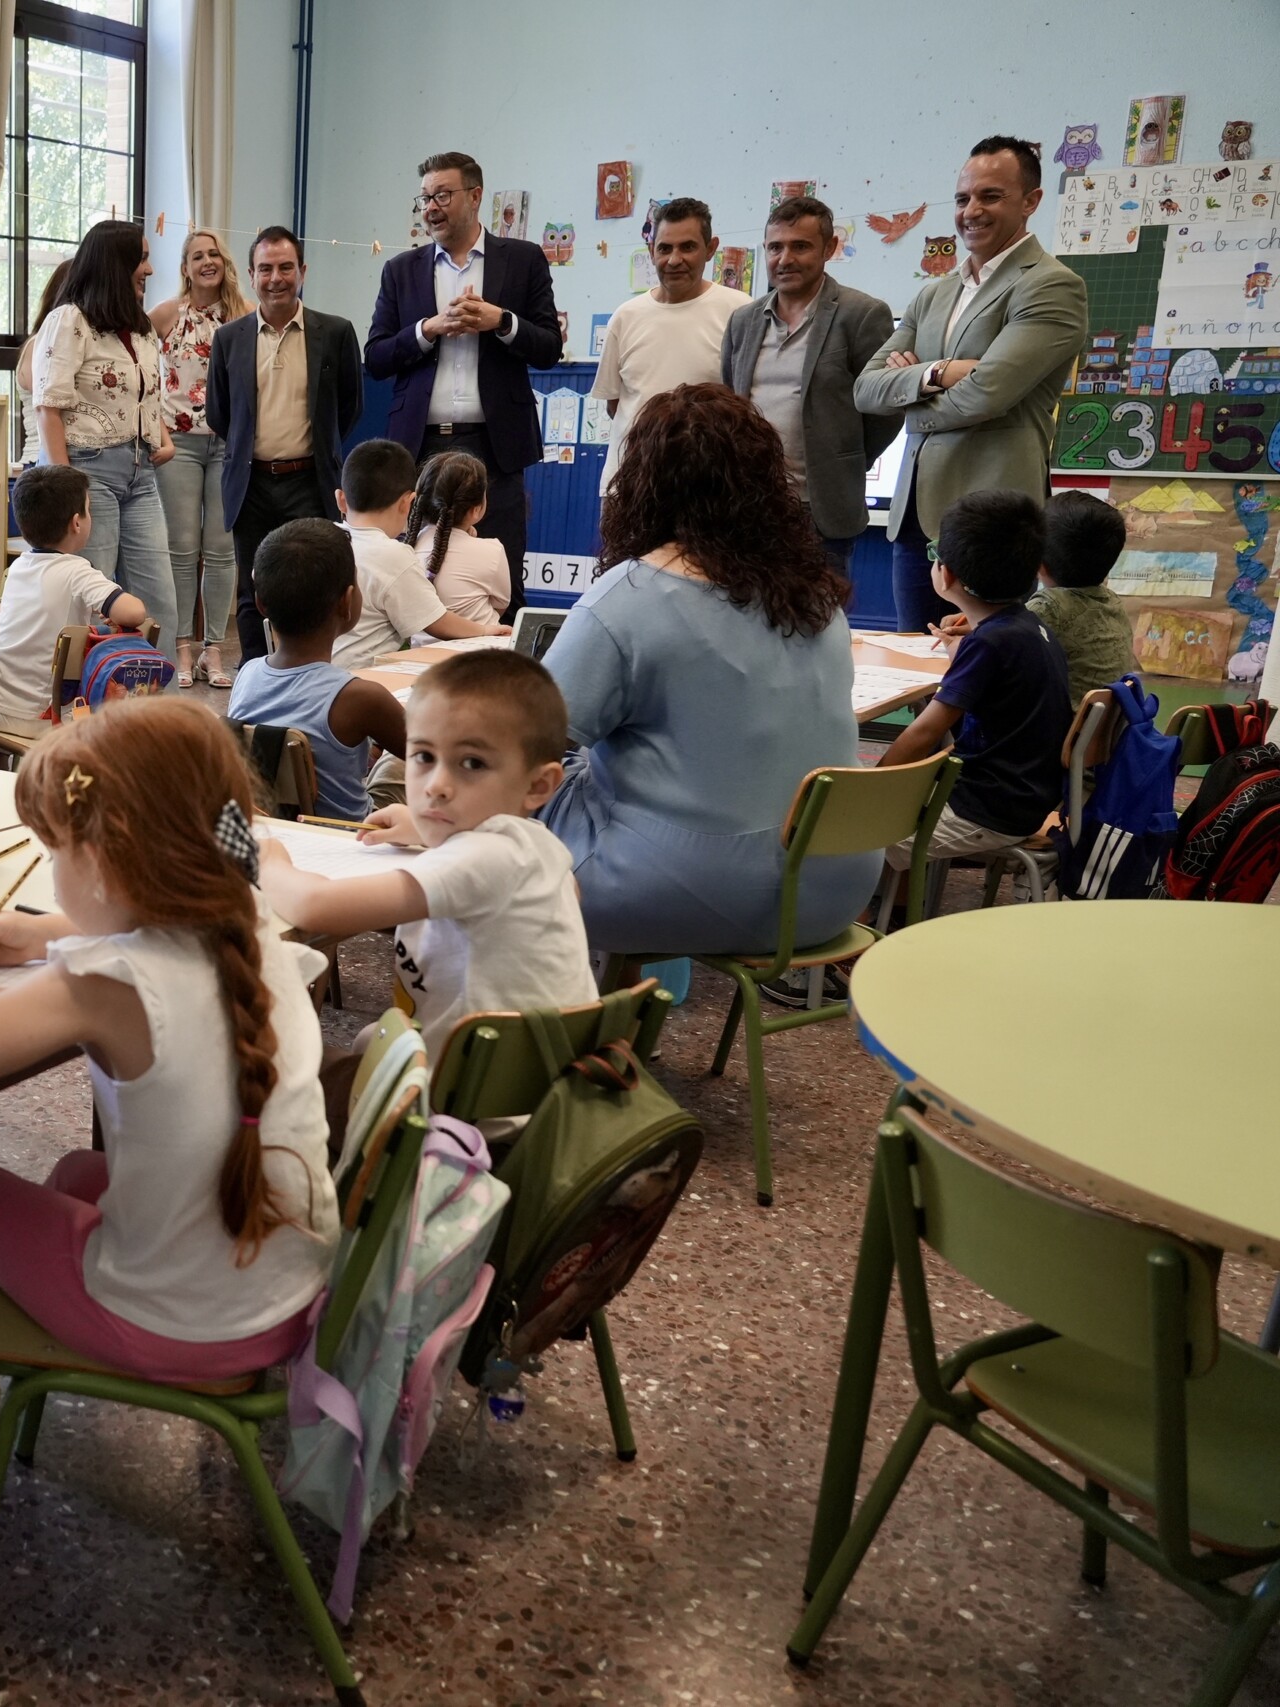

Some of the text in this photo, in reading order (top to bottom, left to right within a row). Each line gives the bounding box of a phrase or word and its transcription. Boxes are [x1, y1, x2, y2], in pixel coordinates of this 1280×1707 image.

[1193, 168, 1211, 182] CH
[1238, 168, 1246, 182] D
[1070, 179, 1078, 192] A
[1108, 176, 1116, 190] B
[1190, 180, 1206, 194] ch
[1068, 194, 1077, 202] a
[1190, 196, 1200, 211] O
[1232, 195, 1242, 209] P
[1064, 206, 1074, 218] M
[1103, 203, 1112, 216] N
[1060, 232, 1068, 244] Y
[1100, 229, 1109, 242] Z
[1190, 241, 1206, 252] a
[1214, 230, 1228, 251] b
[1236, 239, 1248, 250] c
[1179, 322, 1194, 335] n
[1202, 319, 1218, 335] ñ
[1225, 322, 1242, 334] o
[1094, 384, 1104, 394] 10
[1210, 381, 1220, 392] 30
[1058, 401, 1110, 469] 2
[1107, 400, 1156, 469] 3
[1160, 401, 1212, 472] 4
[1209, 403, 1266, 473] 5
[542, 562, 554, 584] 6
[567, 563, 579, 586] 7
